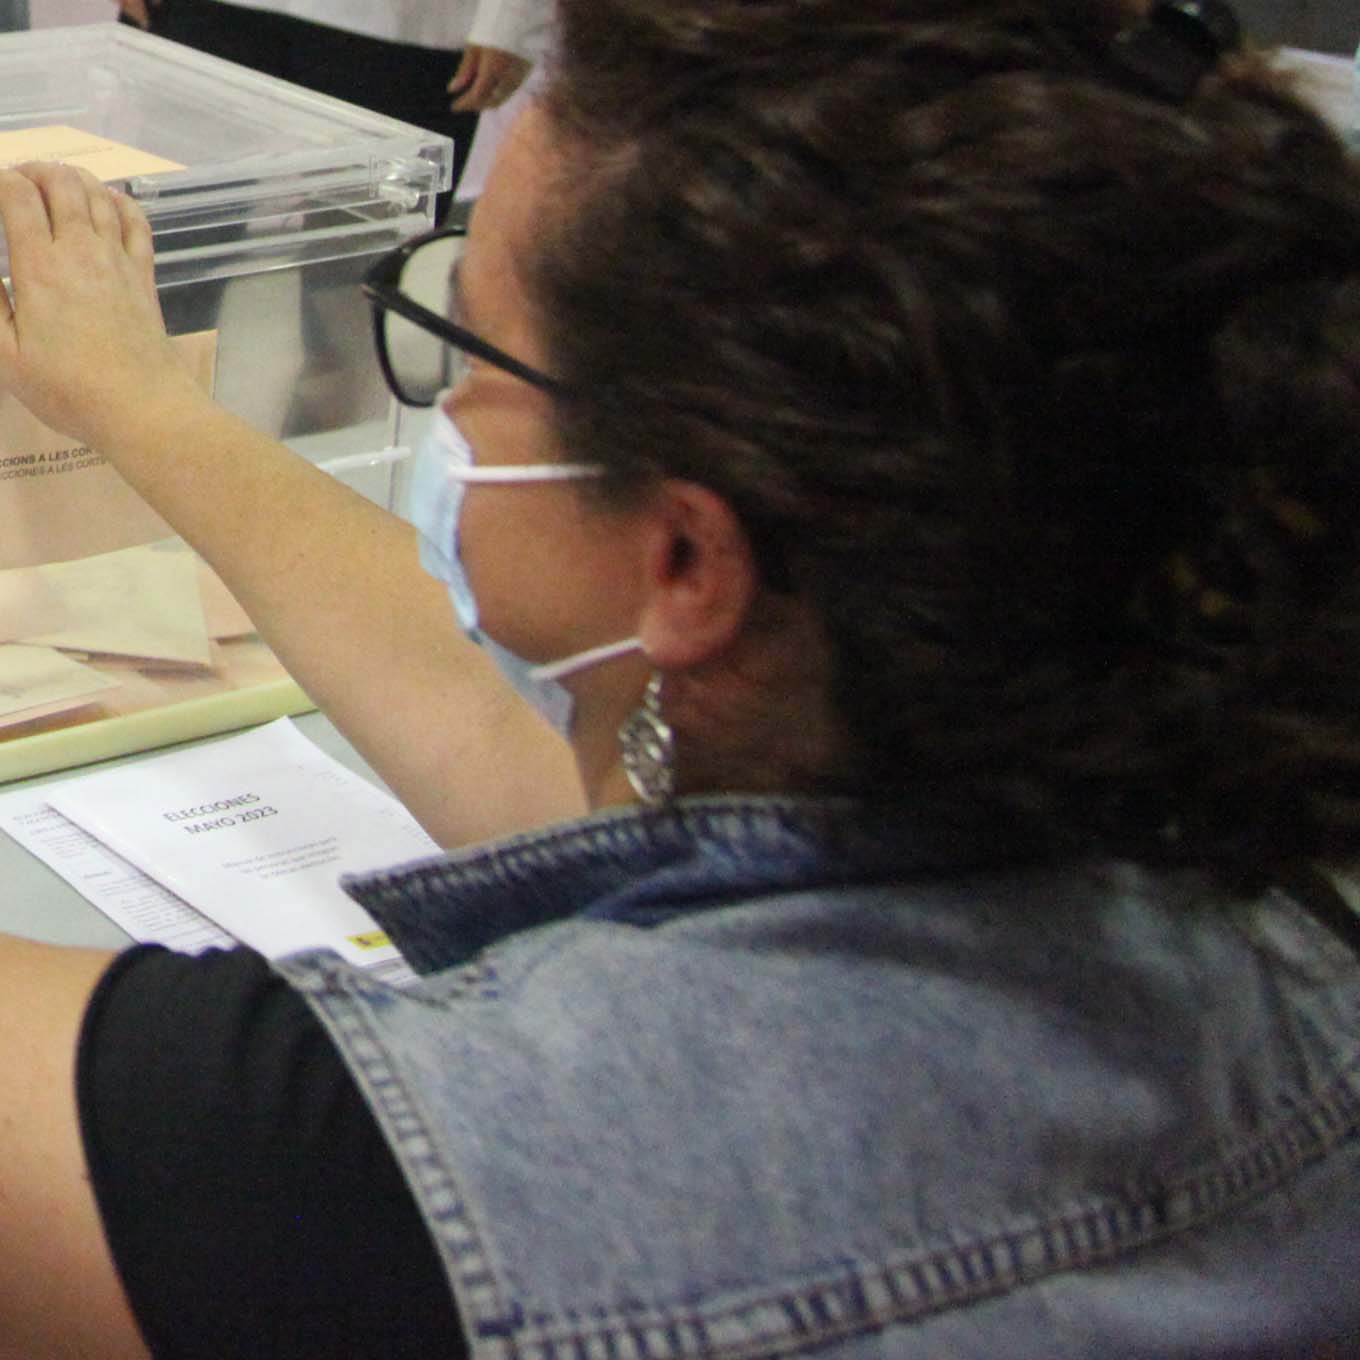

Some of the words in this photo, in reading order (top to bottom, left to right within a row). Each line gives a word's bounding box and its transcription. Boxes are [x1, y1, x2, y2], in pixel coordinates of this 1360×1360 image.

[38, 452, 46, 462] A
[48, 449, 70, 461] LES
[47, 463, 55, 474] A
[162, 792, 261, 822] ELECCIONES
[183, 816, 237, 835] MAYO
[237, 805, 279, 823] 2023
